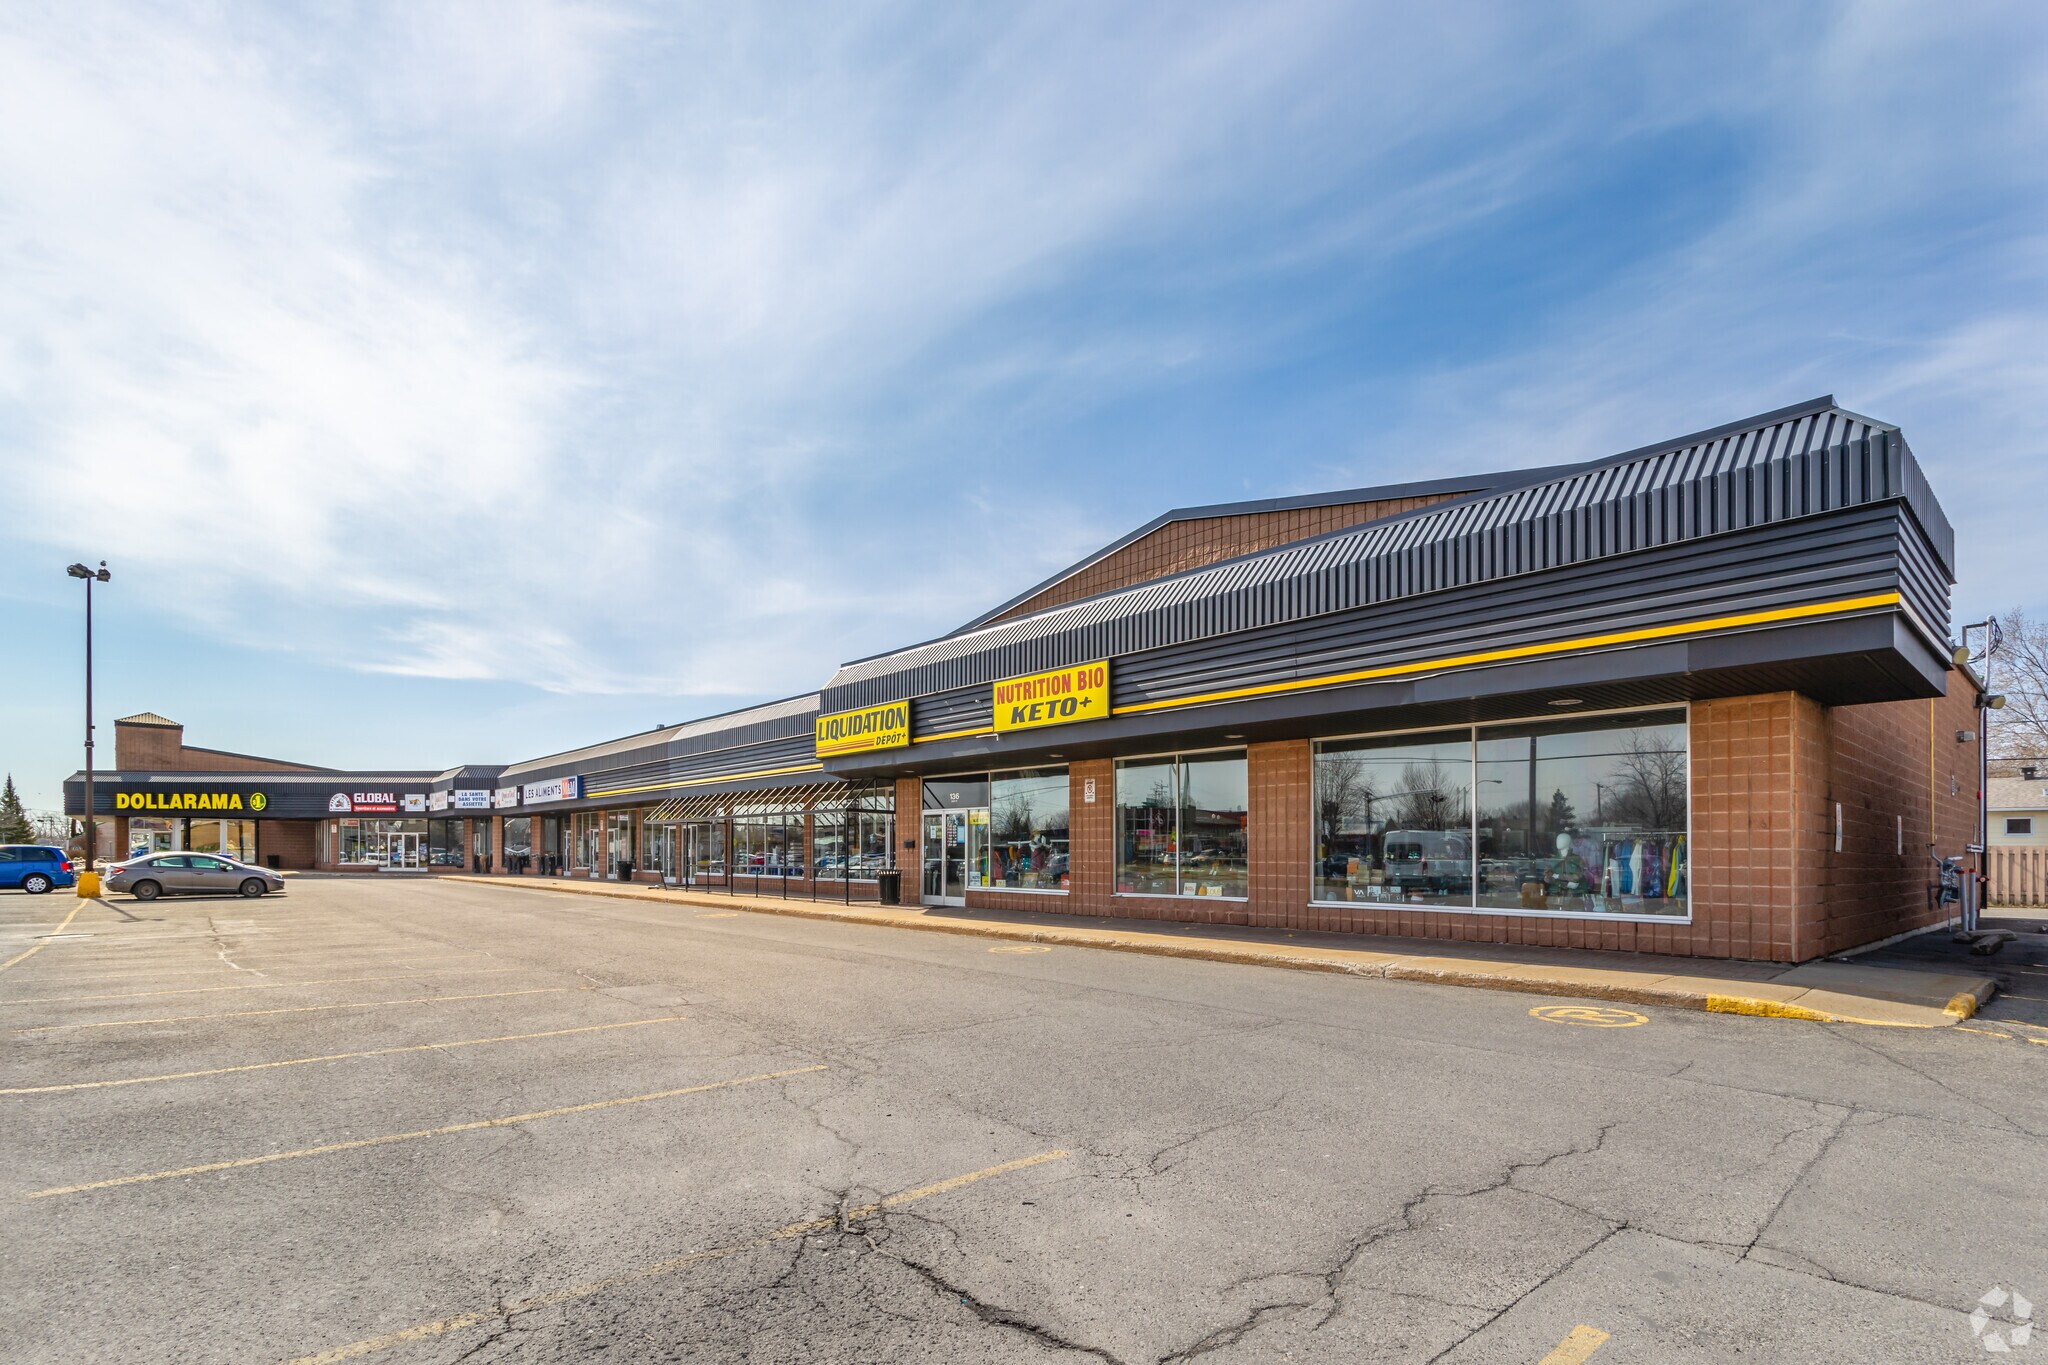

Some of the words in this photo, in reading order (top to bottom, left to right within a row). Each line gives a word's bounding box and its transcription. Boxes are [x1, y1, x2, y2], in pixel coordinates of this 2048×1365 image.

[996, 673, 1072, 705] NUTRITION
[1077, 667, 1104, 691] BIO
[1010, 696, 1092, 725] KETO+
[817, 706, 907, 742] LIQUIDATION
[353, 793, 397, 803] GLOBAL
[525, 789, 534, 799] LES
[535, 785, 562, 798] ALIMENTS
[949, 792, 960, 800] 136
[116, 793, 243, 810] DOLLARAMA
